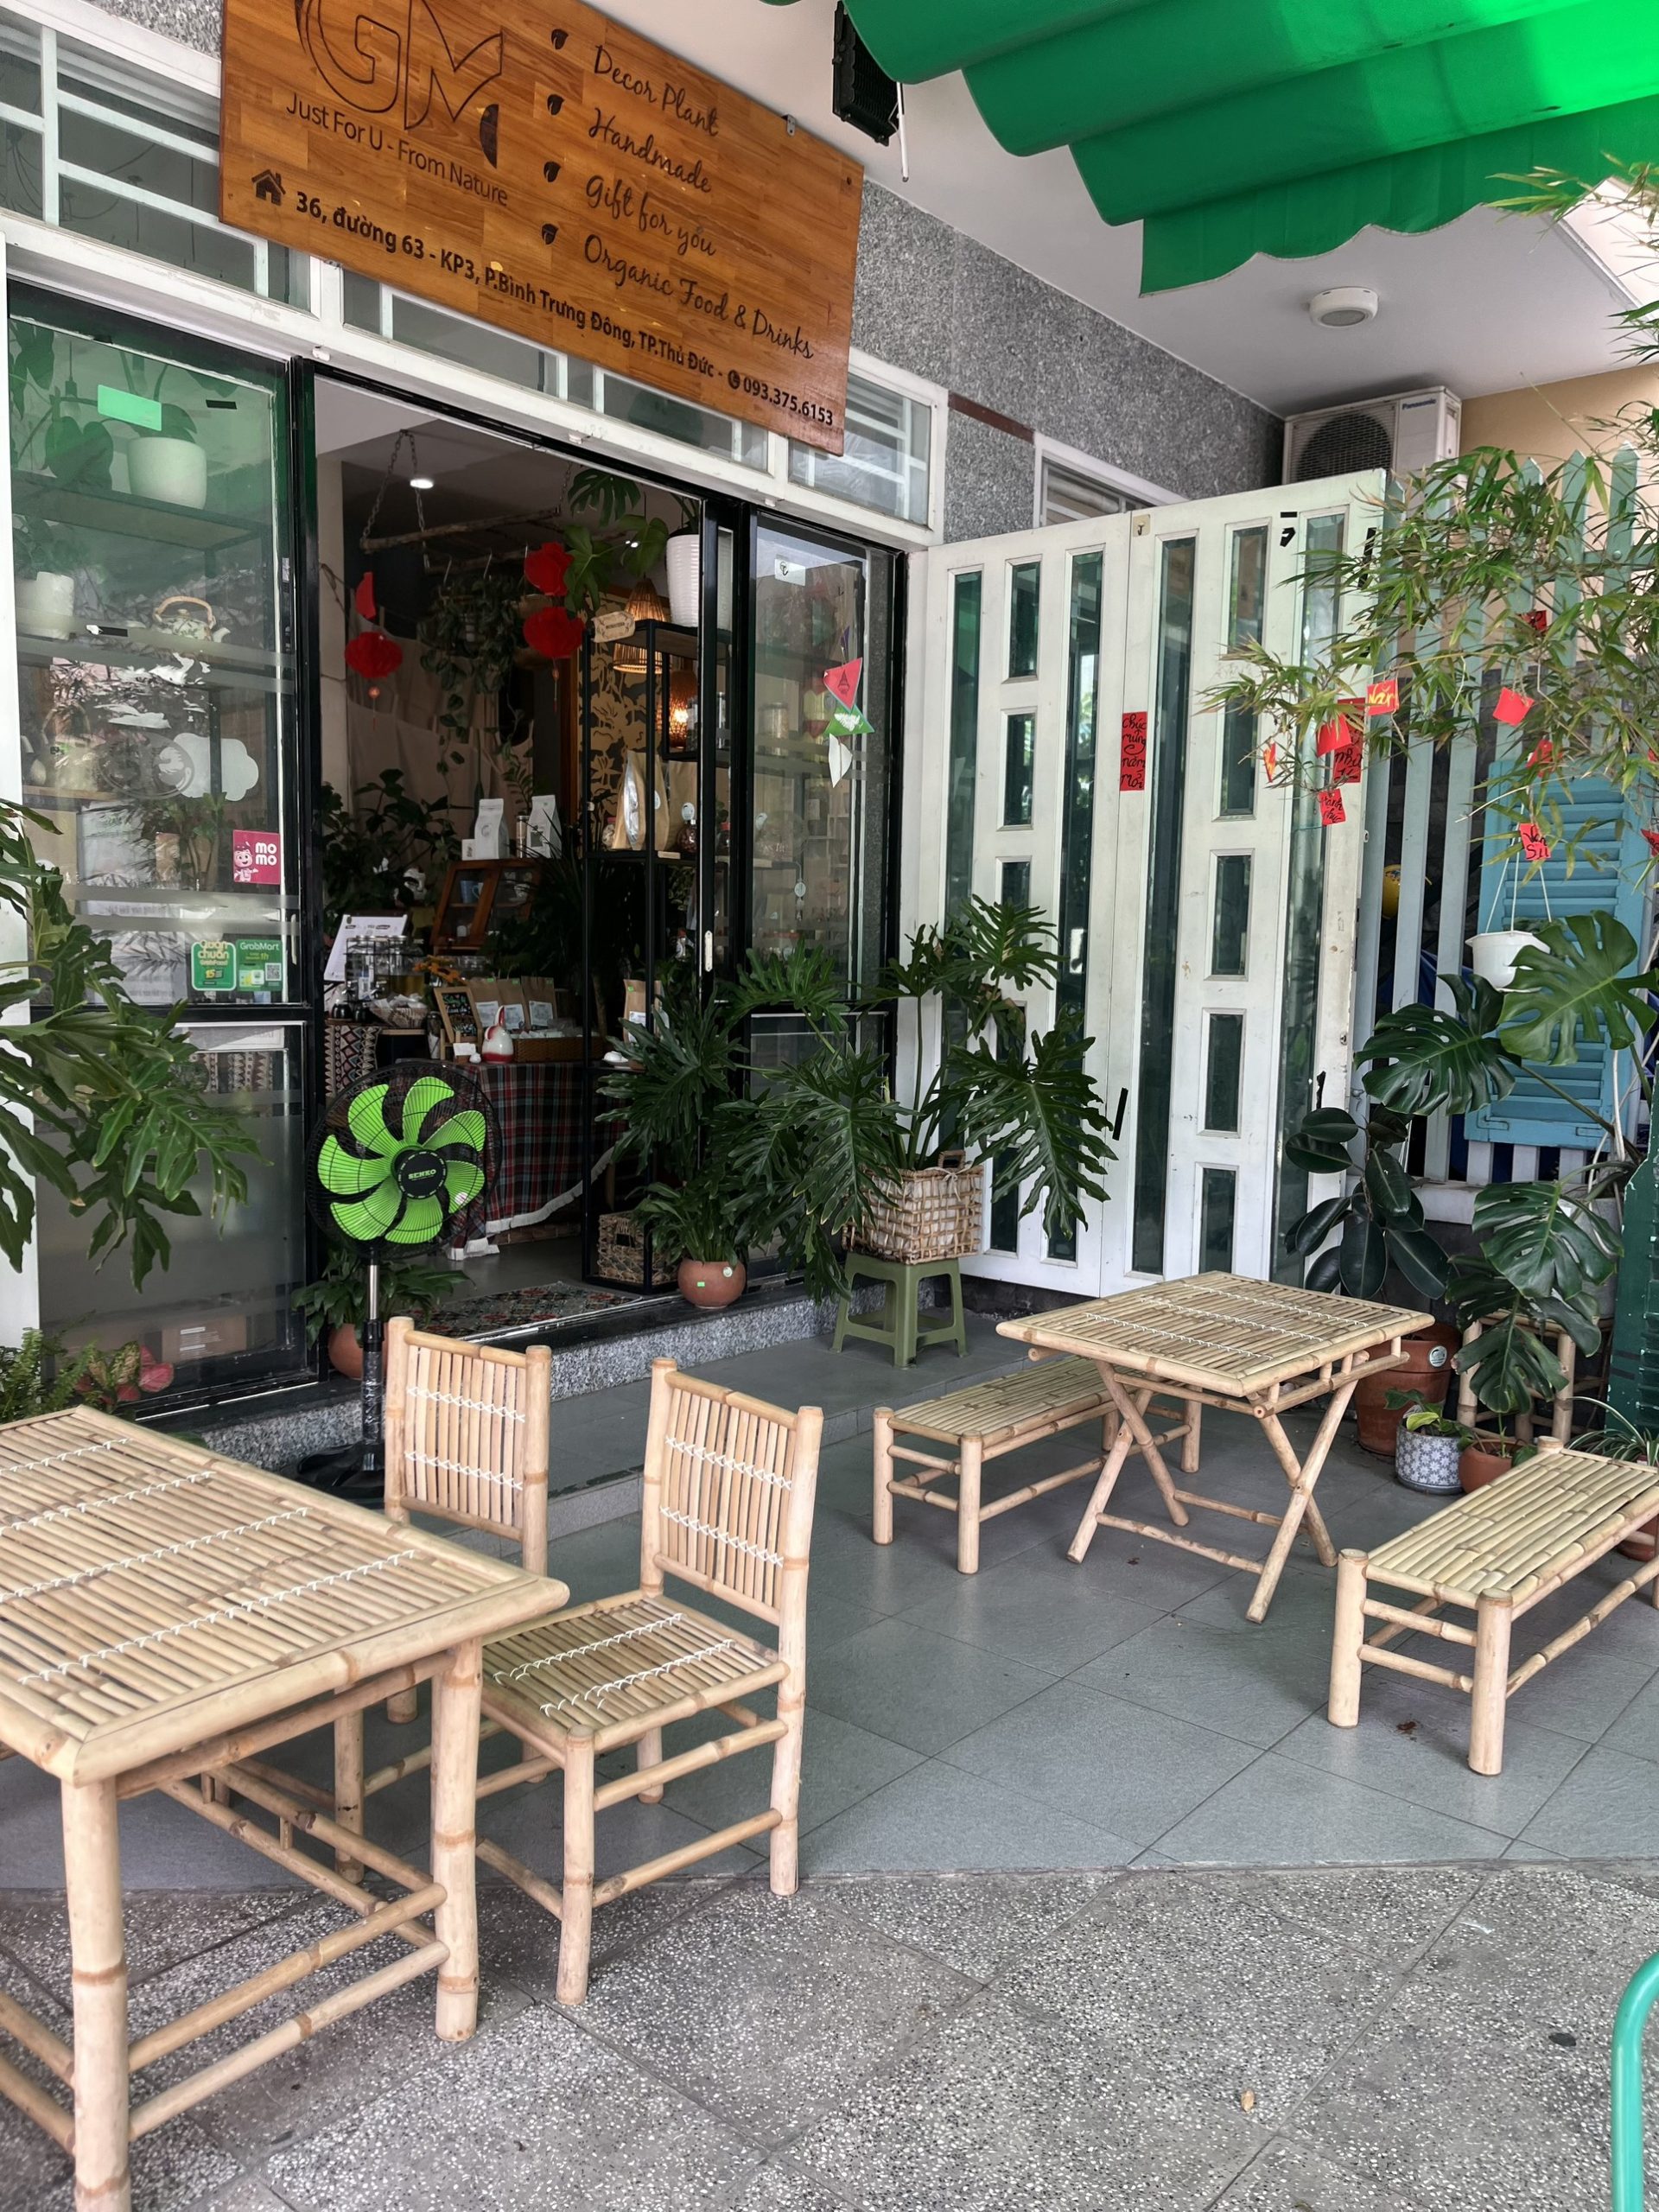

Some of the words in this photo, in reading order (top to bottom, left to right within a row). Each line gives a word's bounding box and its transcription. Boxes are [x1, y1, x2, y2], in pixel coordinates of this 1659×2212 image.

[594, 45, 658, 103] Decor
[662, 83, 719, 137] Plant
[286, 92, 329, 130] Just
[334, 110, 366, 143] For
[369, 124, 383, 151] U
[397, 138, 446, 179] From
[449, 162, 508, 207] Nature
[588, 107, 712, 194] Handmade
[586, 175, 634, 219] Gift
[639, 191, 673, 232] for
[677, 227, 717, 256] you
[296, 190, 327, 225] 36,
[333, 206, 397, 253] đường
[402, 234, 424, 259] 63
[441, 248, 480, 285] KP3,
[485, 265, 537, 305] P.Bình
[539, 289, 586, 330] Trưng
[590, 311, 635, 349] Đông,
[638, 330, 684, 366] TP.Thủ
[688, 351, 715, 378] Đức
[743, 377, 834, 427] 093.375.6153
[584, 233, 674, 296] Organic
[679, 277, 730, 321] Food
[734, 304, 747, 330] &
[752, 308, 814, 359] Drinks
[239, 942, 280, 951] GrabMart
